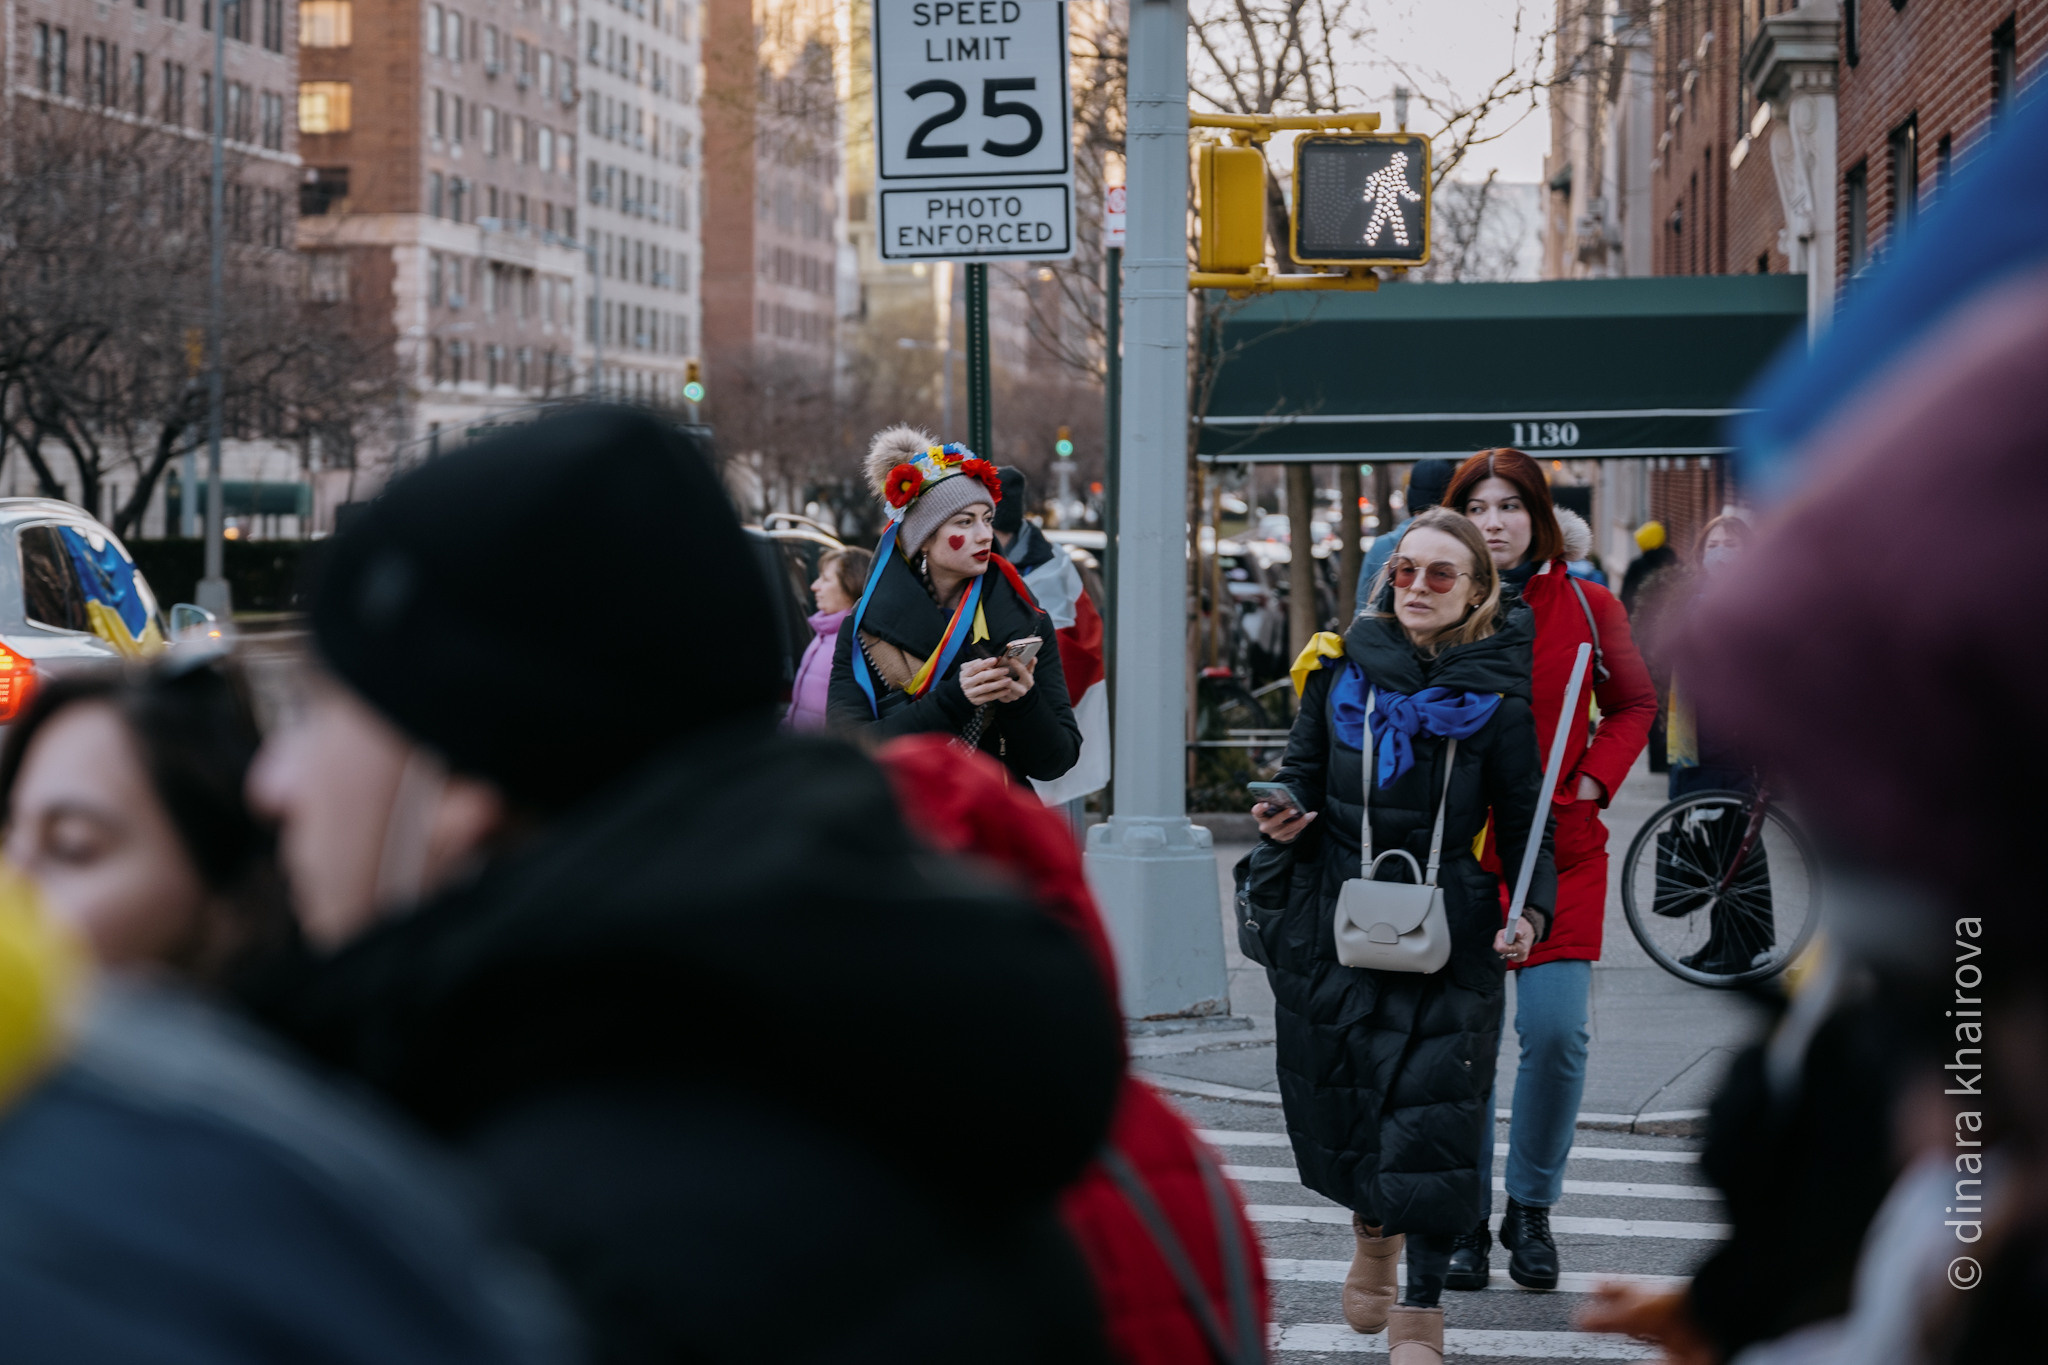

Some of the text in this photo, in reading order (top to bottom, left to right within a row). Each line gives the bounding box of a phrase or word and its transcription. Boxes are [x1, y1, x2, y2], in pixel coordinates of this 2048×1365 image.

[912, 1, 1020, 26] SPEED
[925, 37, 1011, 62] LIMIT
[904, 77, 1043, 159] 25
[928, 196, 1022, 219] PHOTO
[898, 222, 1053, 247] ENFORCED
[1510, 422, 1580, 447] 1130
